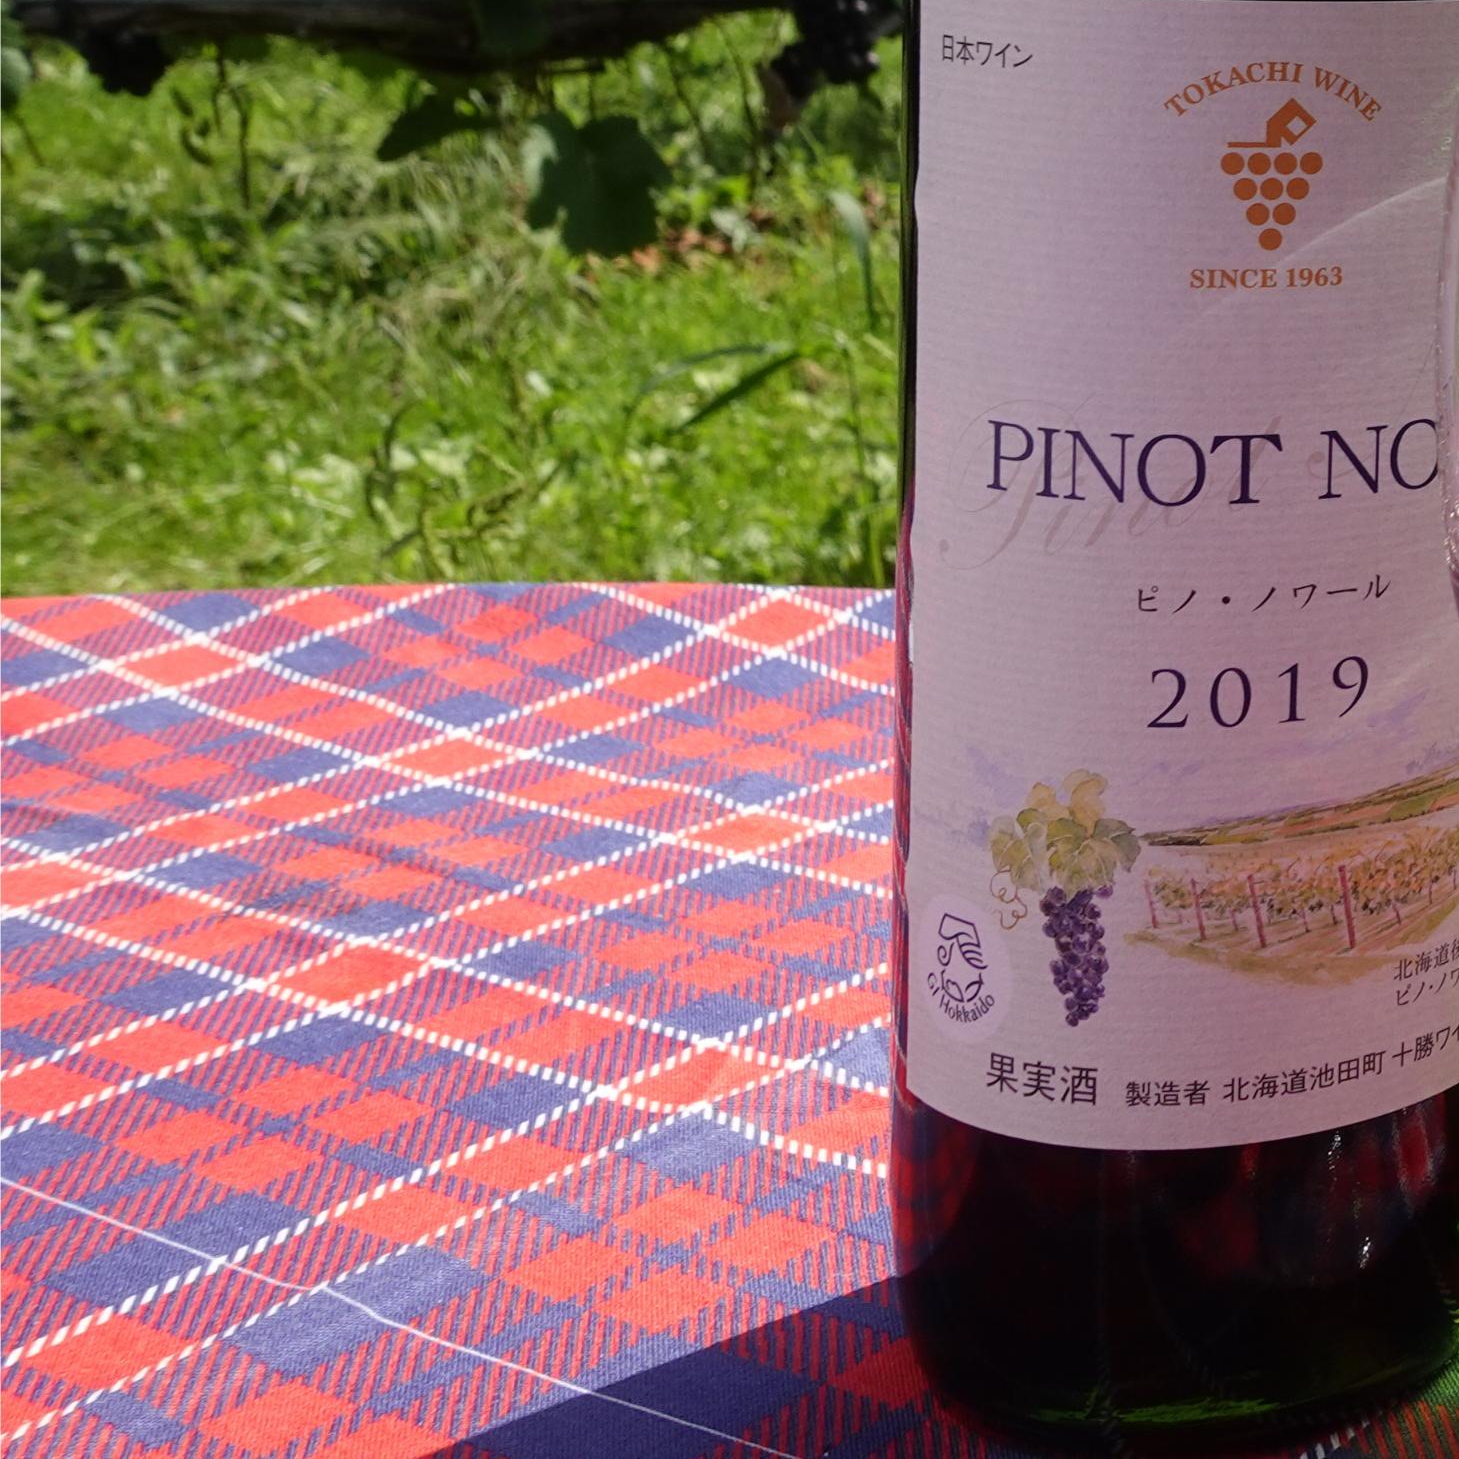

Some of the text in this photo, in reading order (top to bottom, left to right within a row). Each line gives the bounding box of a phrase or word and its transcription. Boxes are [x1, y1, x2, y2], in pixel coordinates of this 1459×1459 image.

[941, 35, 1033, 68] 日本ワイン
[1164, 61, 1382, 121] TOKACHI WINE
[1190, 266, 1342, 288] SINCE 1963
[985, 419, 1284, 507] PINOT
[1137, 572, 1391, 614] ピノ・ノワール
[1147, 656, 1369, 729] 2019
[939, 994, 996, 1023] Hokkaido
[985, 1052, 1098, 1105] 果実酒
[1125, 1081, 1210, 1108] 製造者
[1222, 1050, 1386, 1103] 北海道池田町
